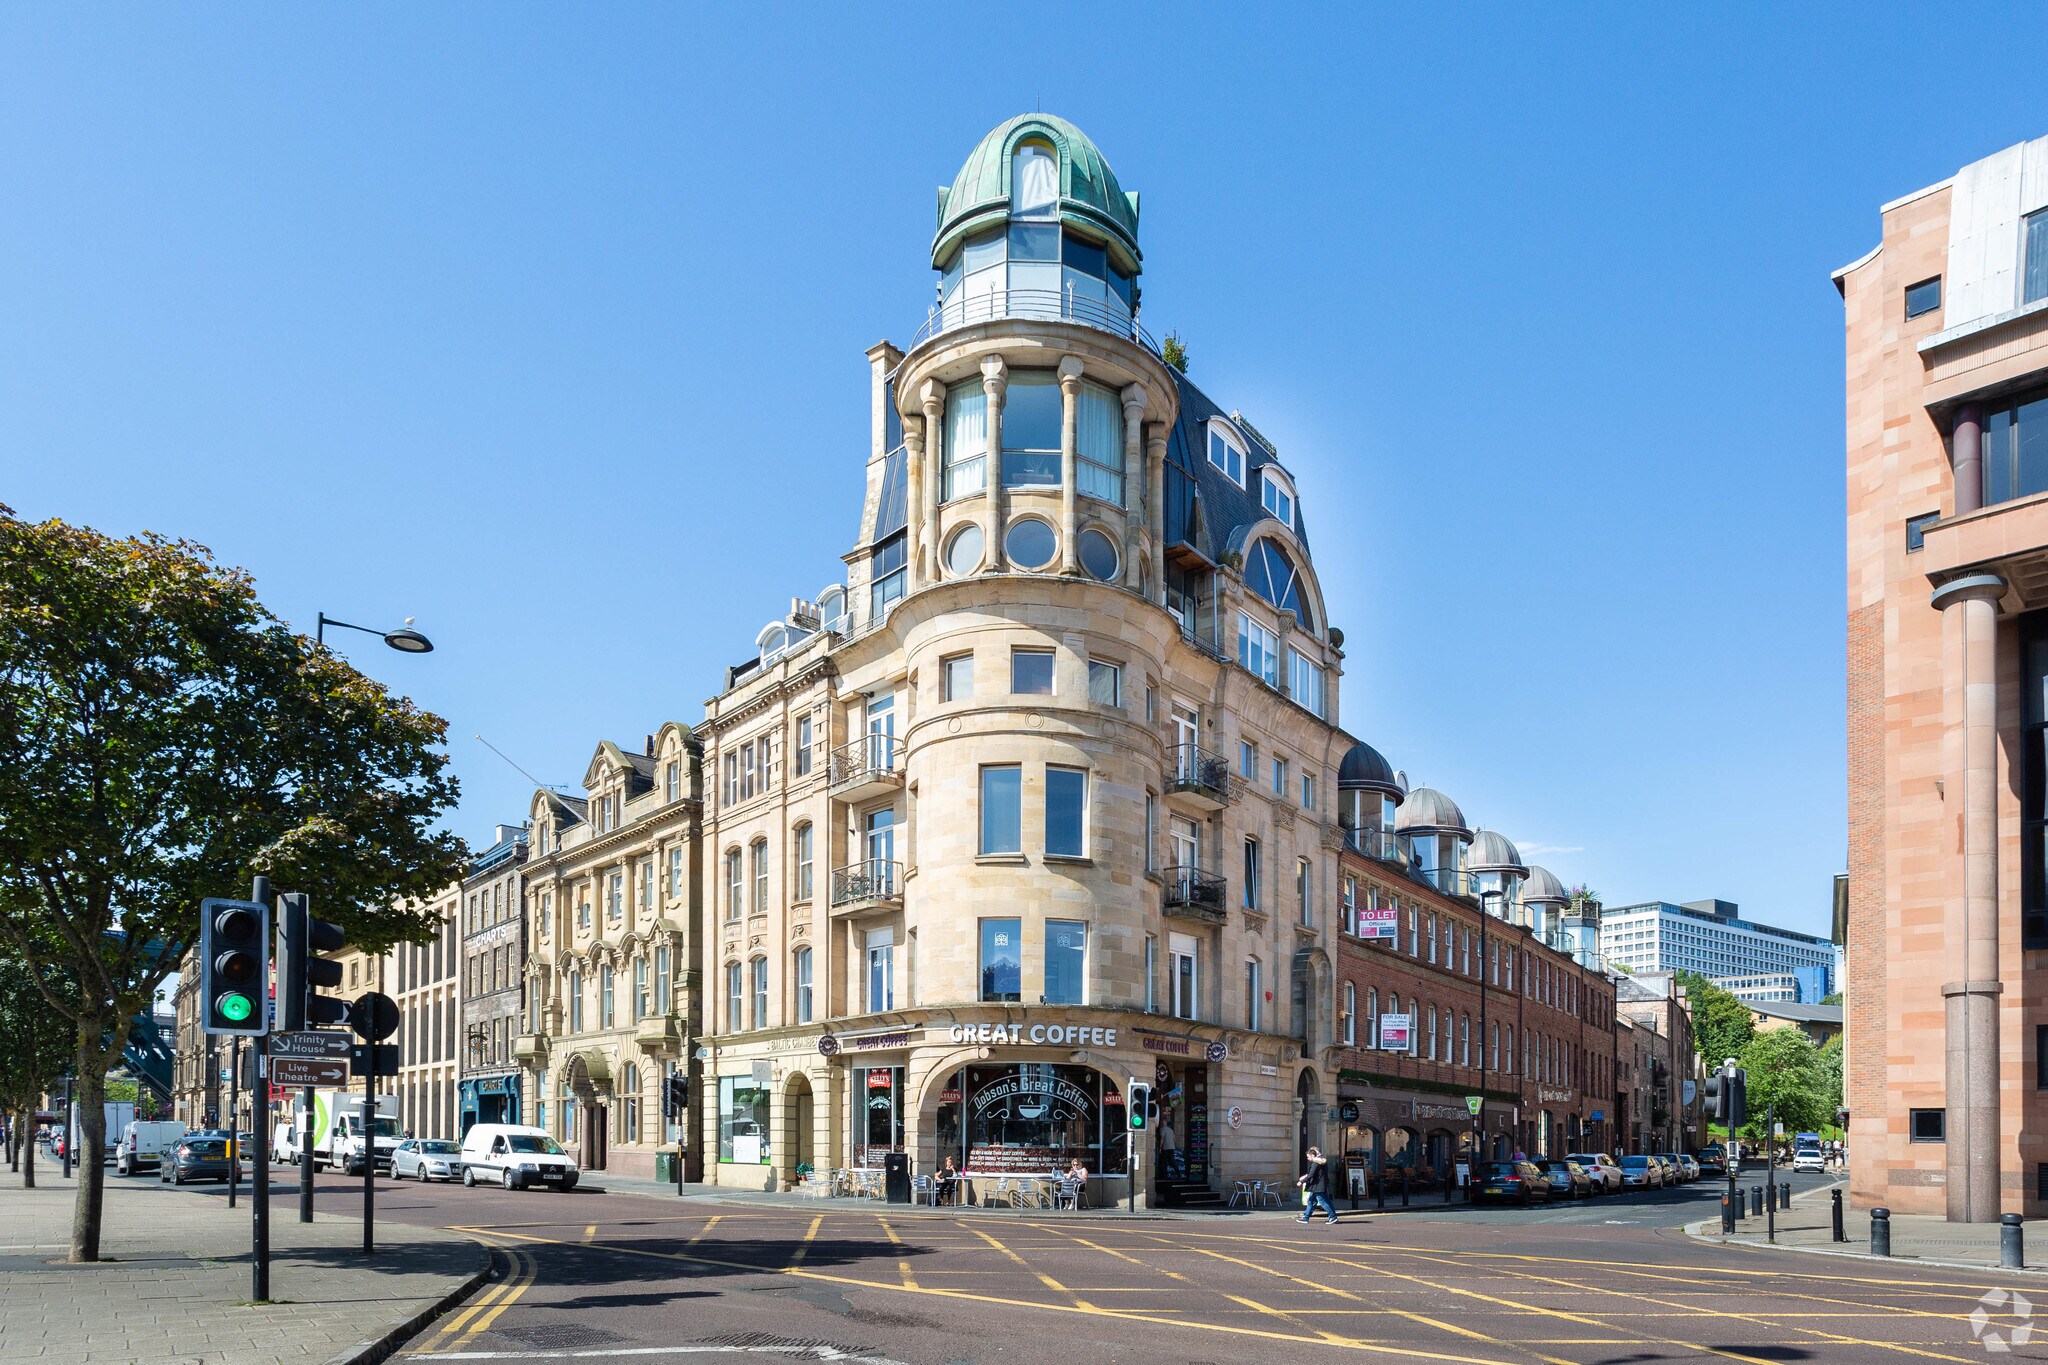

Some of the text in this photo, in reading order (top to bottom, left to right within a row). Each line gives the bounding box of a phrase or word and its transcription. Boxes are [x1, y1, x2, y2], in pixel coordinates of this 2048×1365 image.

[1361, 910, 1396, 920] TO LET
[476, 925, 506, 946] CHARTS
[293, 1035, 325, 1045] Trinity
[950, 1023, 1117, 1047] GREAT COFFEE
[771, 1038, 791, 1050] BALTIC
[856, 1034, 908, 1050] GREAT COFFEE
[1143, 1037, 1189, 1055] GREAT COFFEE
[293, 1045, 325, 1053] House
[288, 1064, 308, 1072] Live
[278, 1072, 318, 1081] Theatre
[870, 1075, 889, 1083] KELLY'S
[974, 1077, 1089, 1112] Dobson's Great Coffee
